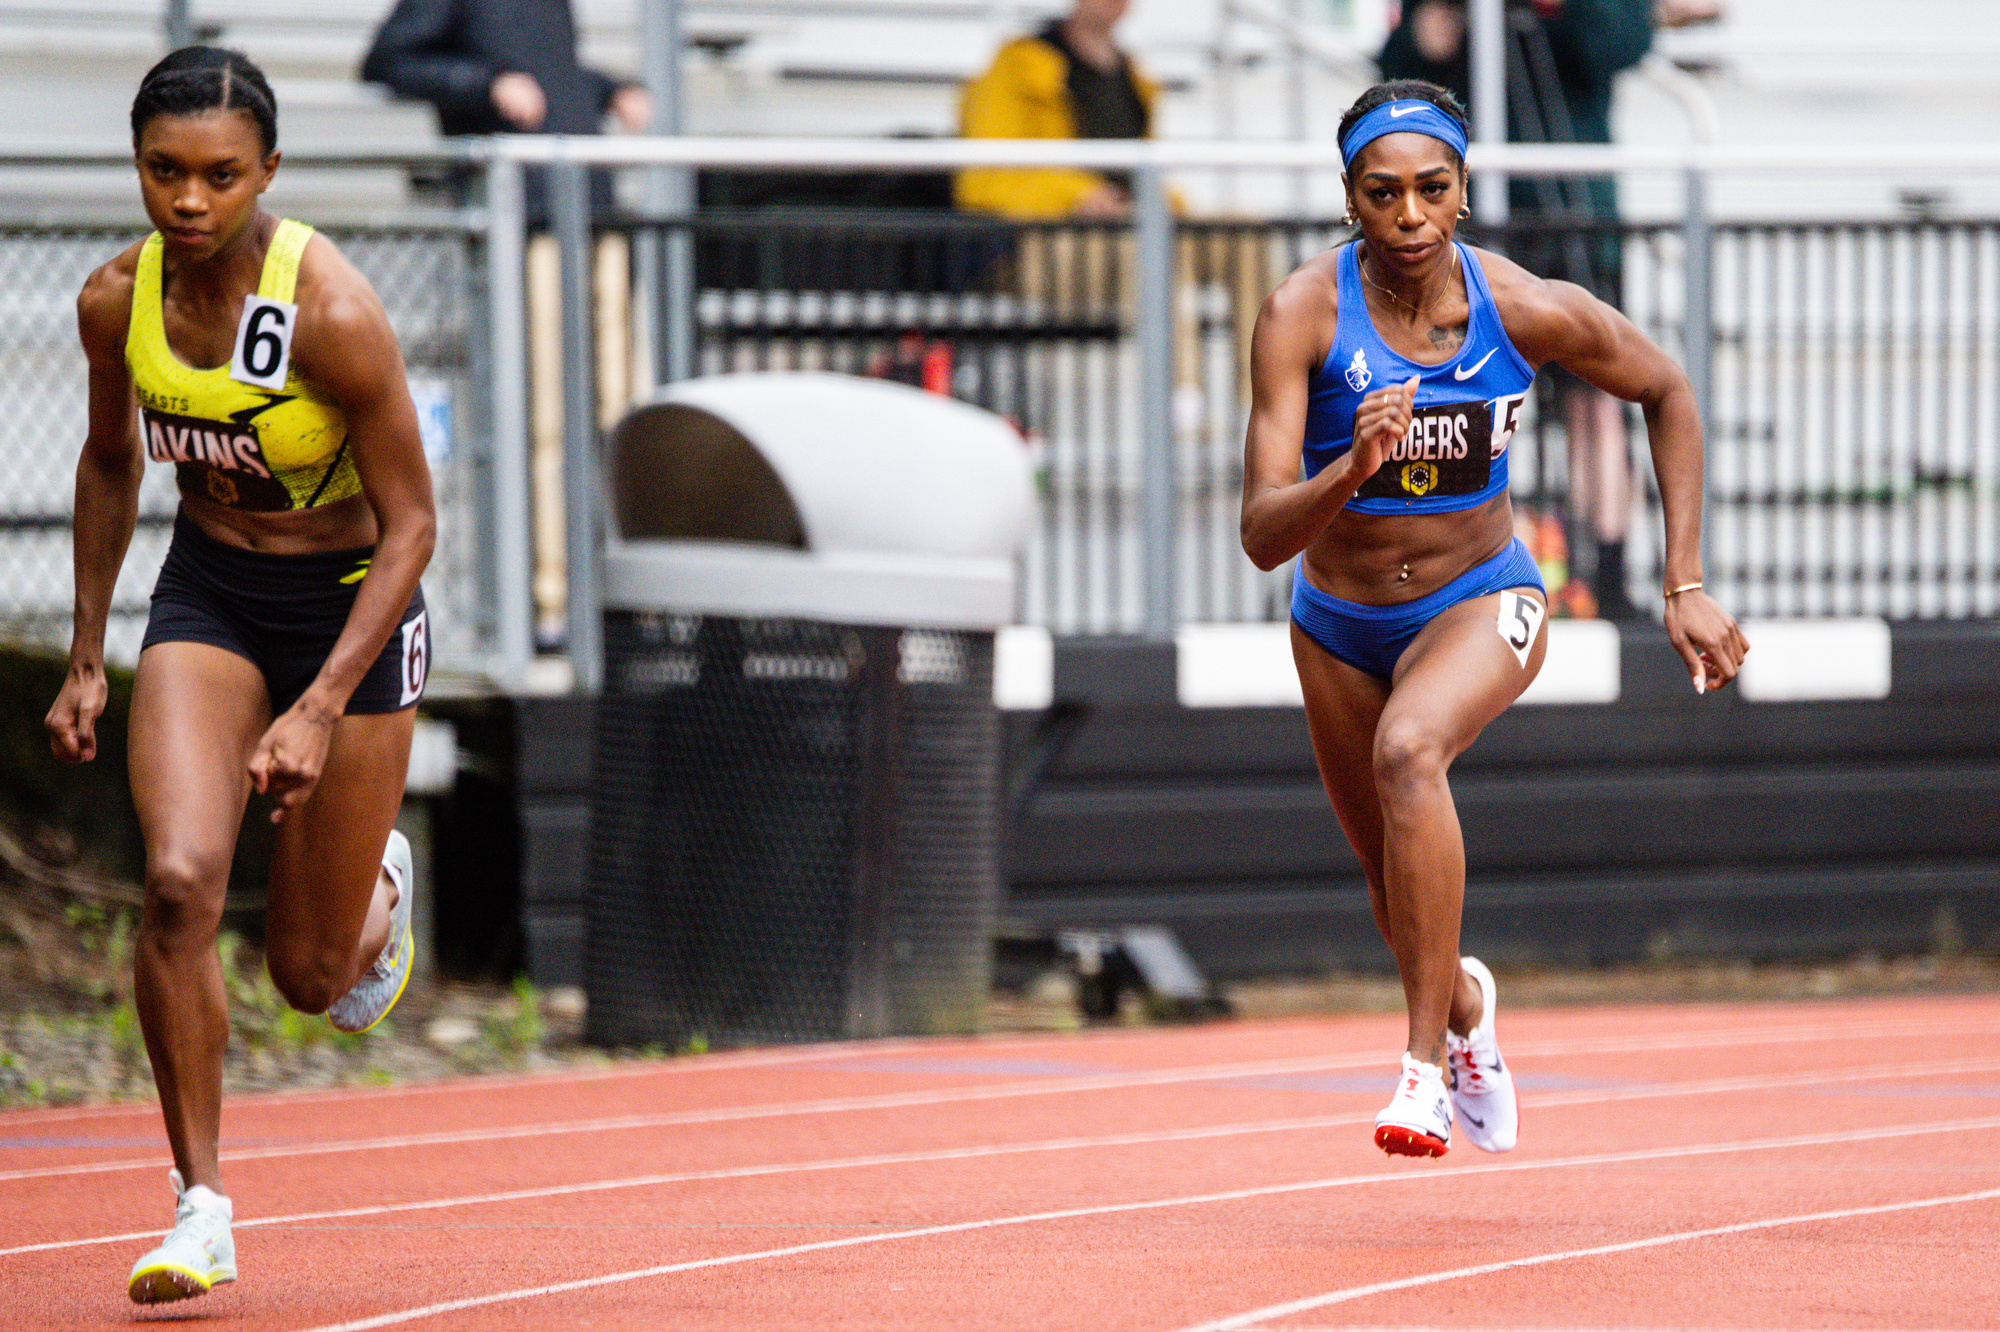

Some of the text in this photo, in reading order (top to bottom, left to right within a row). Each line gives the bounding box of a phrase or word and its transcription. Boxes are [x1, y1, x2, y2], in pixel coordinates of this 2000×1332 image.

[242, 305, 286, 379] 6
[149, 420, 272, 480] AKINS
[1384, 413, 1469, 462] OGERS
[1509, 594, 1538, 652] 5
[408, 622, 422, 694] 6
